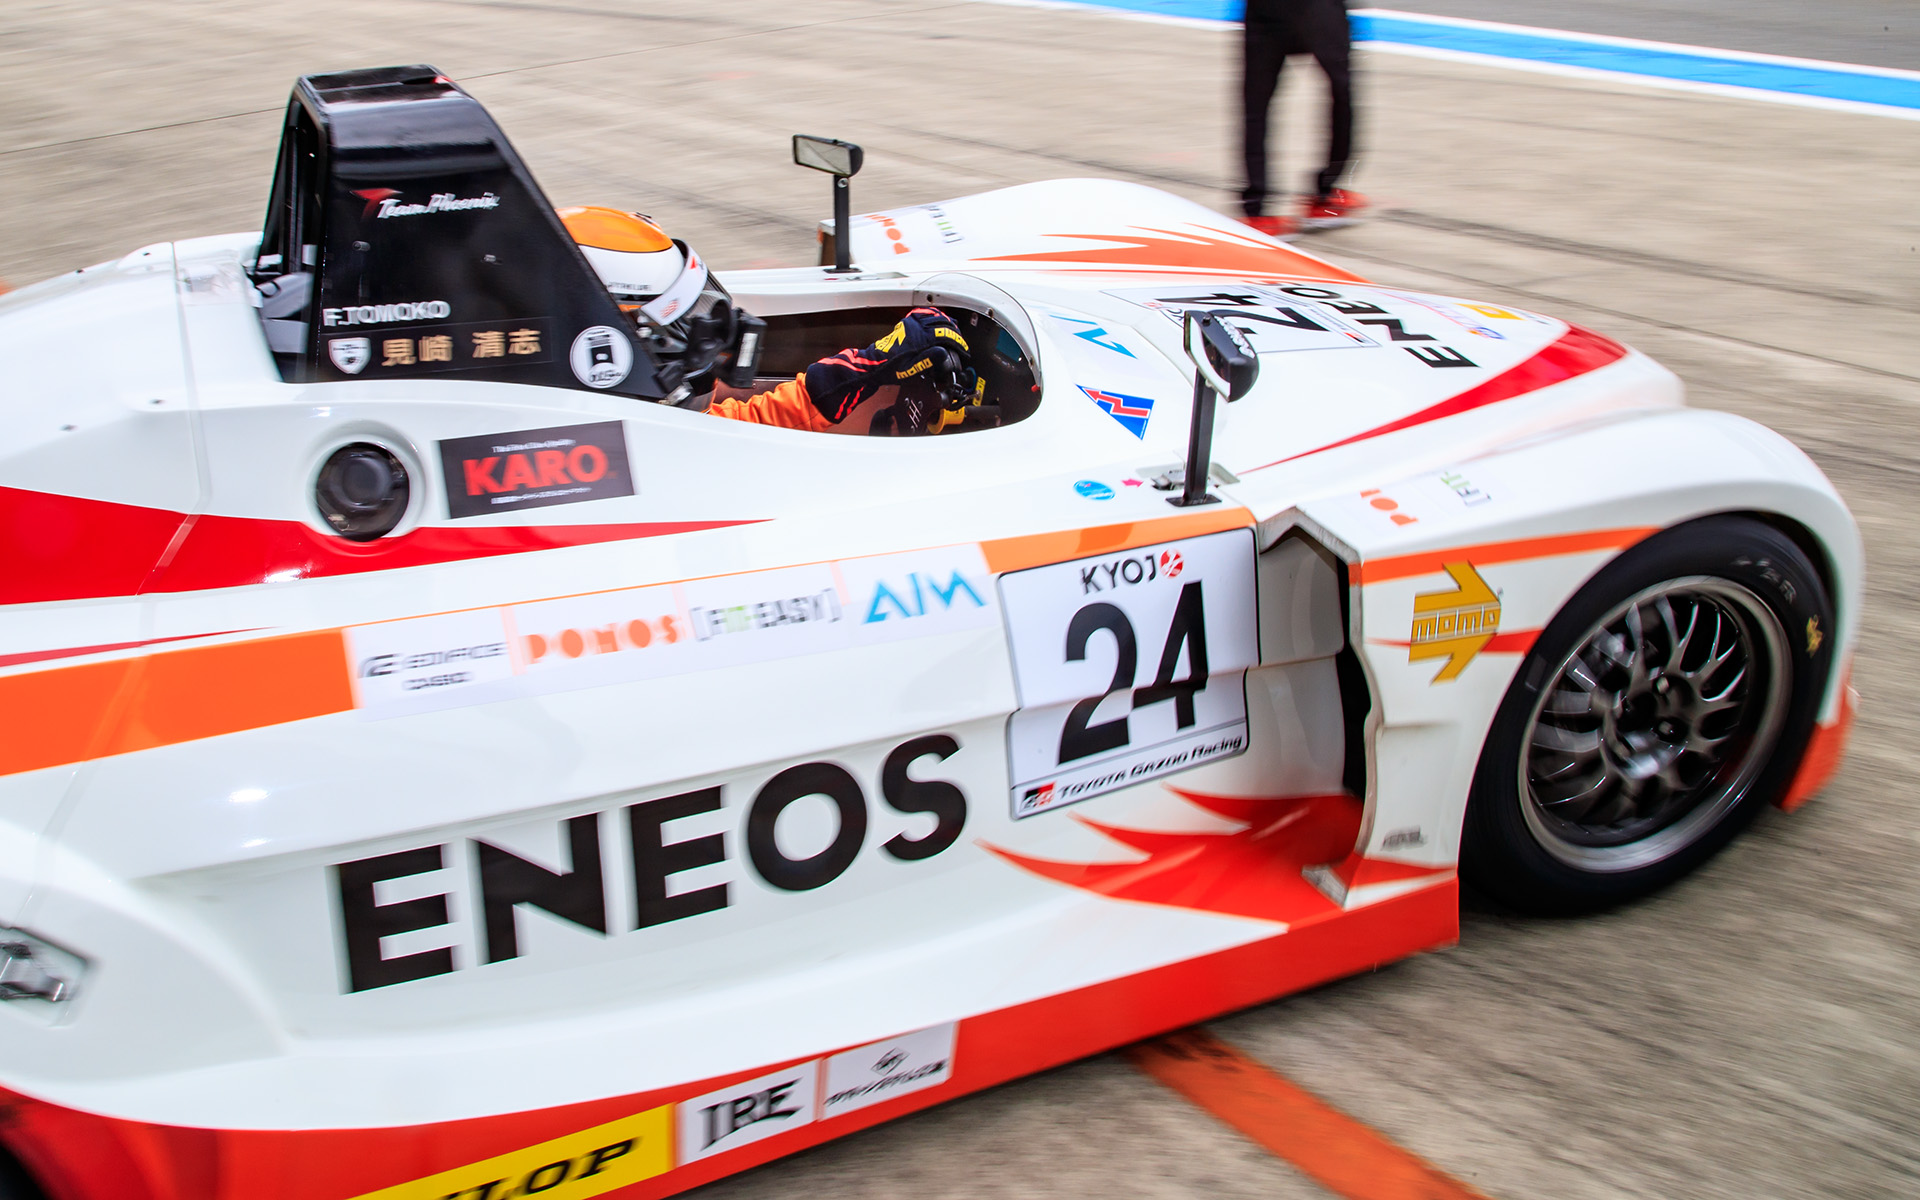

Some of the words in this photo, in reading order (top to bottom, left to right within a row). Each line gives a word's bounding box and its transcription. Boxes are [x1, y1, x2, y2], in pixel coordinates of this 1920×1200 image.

[462, 444, 609, 497] KARO
[1056, 580, 1209, 766] 24
[1057, 769, 1127, 800] TOYOTA
[1129, 750, 1188, 779] GAZOO
[1190, 735, 1243, 762] Racing
[327, 733, 969, 995] ENEOS
